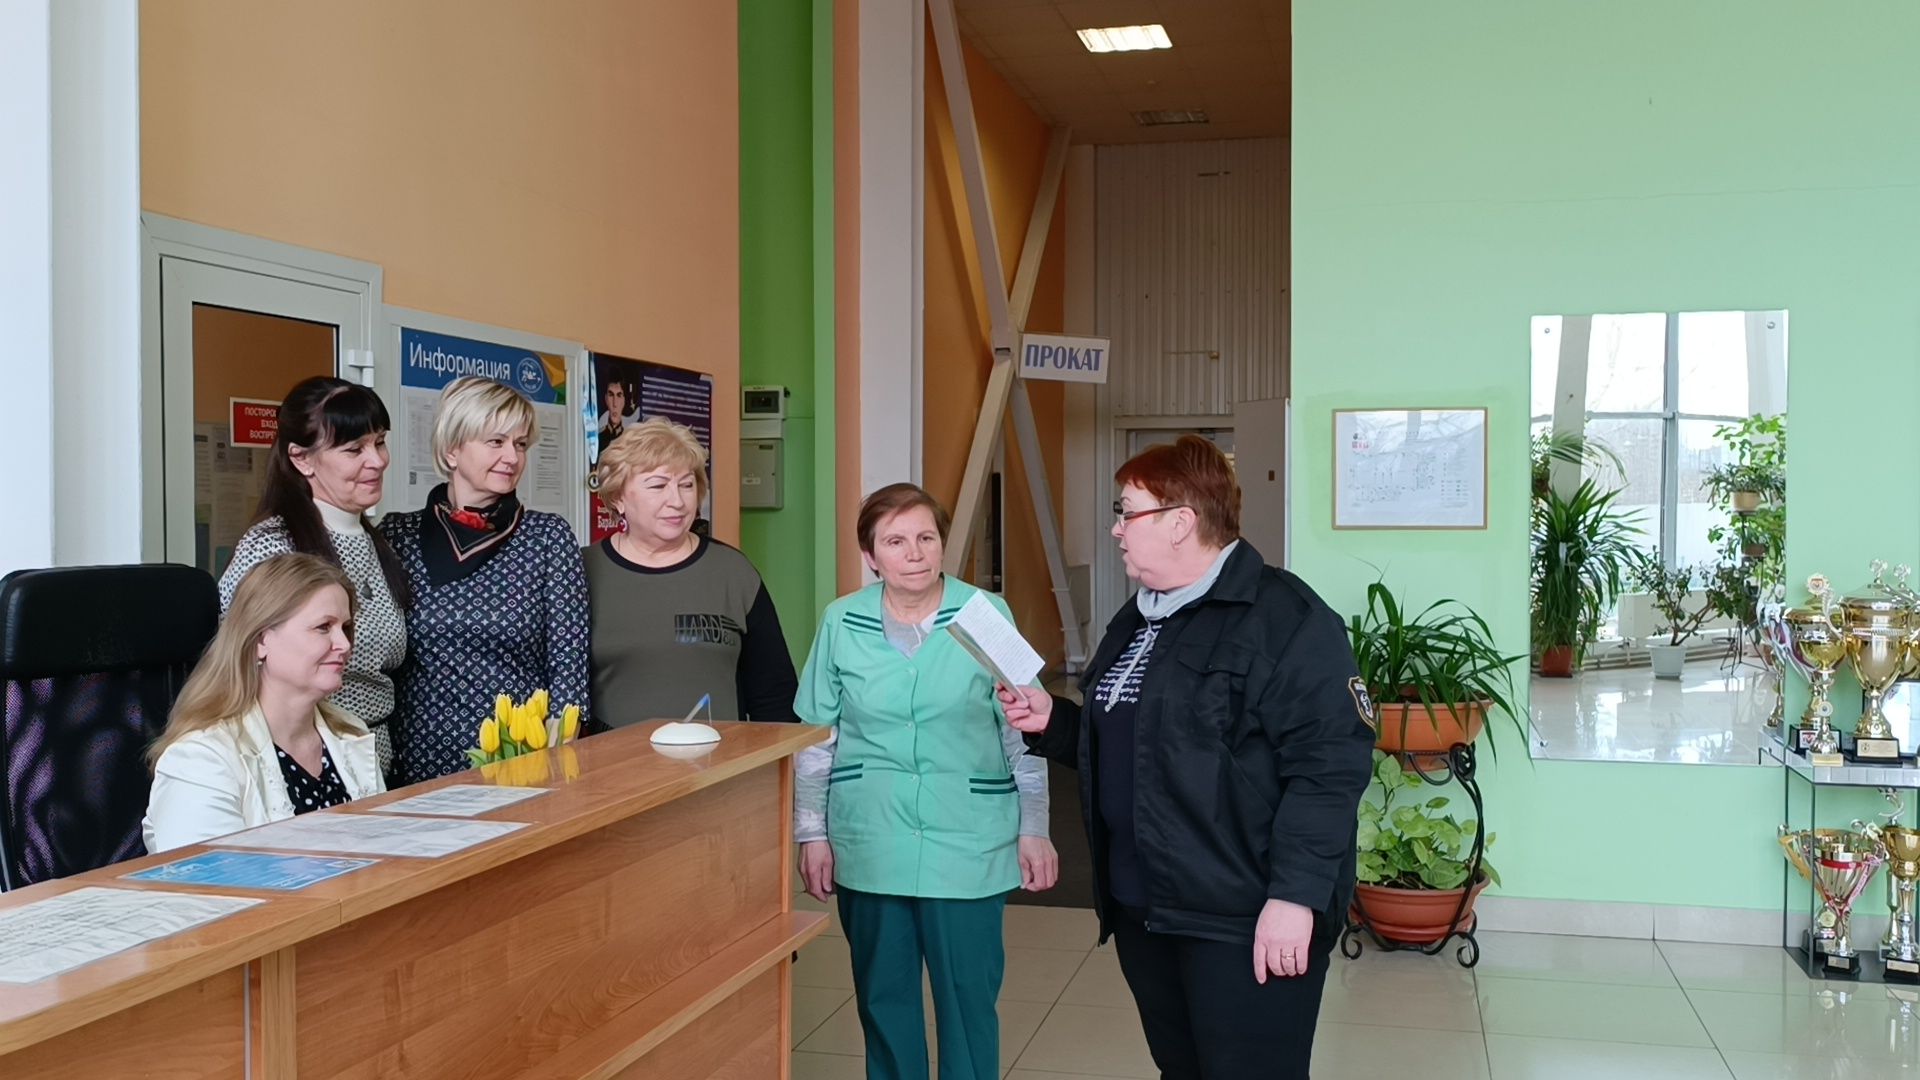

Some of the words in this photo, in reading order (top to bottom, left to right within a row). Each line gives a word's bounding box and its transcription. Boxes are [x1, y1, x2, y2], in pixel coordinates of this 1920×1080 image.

[409, 341, 511, 381] Информация
[1025, 344, 1104, 371] ПРОКАТ
[244, 406, 277, 418] ПОСТОРО
[249, 429, 277, 440] ВОСПРЕ
